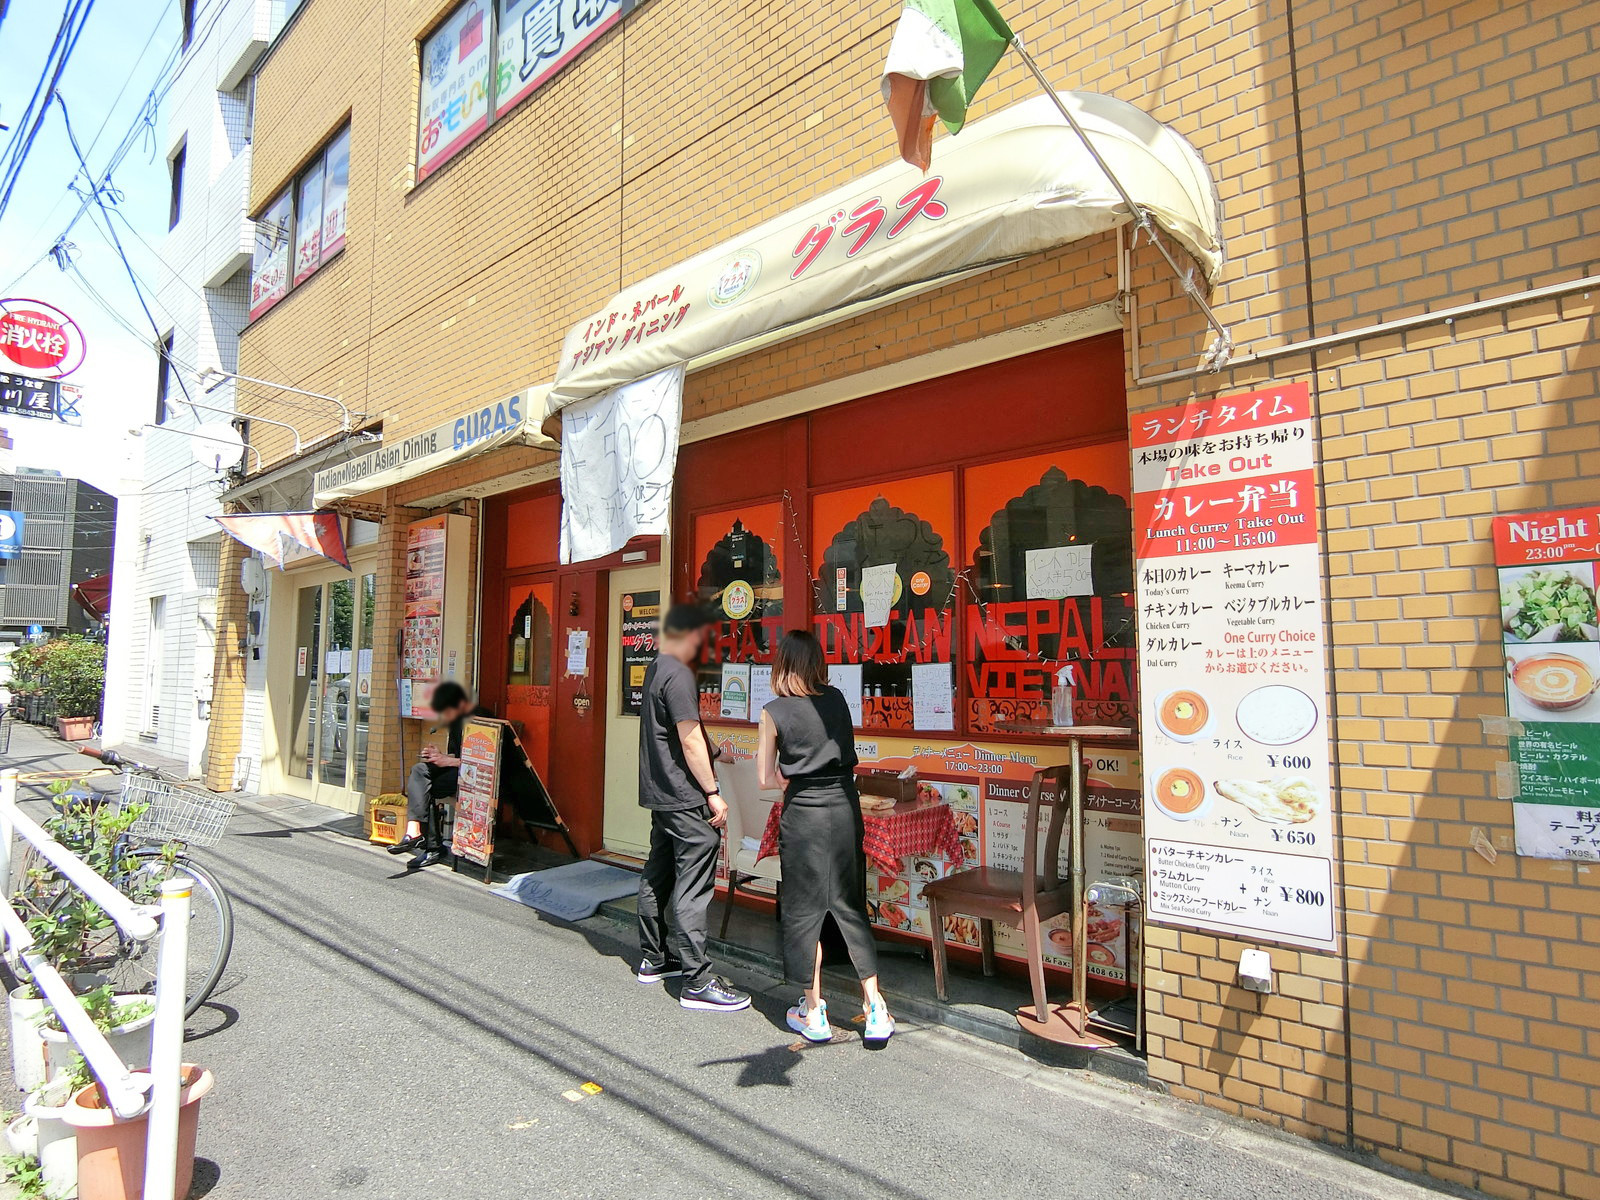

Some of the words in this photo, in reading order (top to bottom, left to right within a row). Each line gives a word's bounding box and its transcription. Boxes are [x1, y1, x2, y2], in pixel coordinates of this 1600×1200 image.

[790, 175, 949, 281] グラス
[0, 321, 66, 357] 消火栓
[453, 395, 522, 451] GURAS
[1142, 395, 1293, 440] ランチタイム
[375, 448, 401, 473] Asian
[403, 432, 438, 462] Dining
[1137, 427, 1305, 465] 本場の味をお持ち帰り
[1166, 461, 1221, 482] Take
[1228, 453, 1273, 472] Out
[1153, 480, 1298, 522] カレー弁当
[1146, 525, 1186, 539] Lunch
[1190, 521, 1229, 536] Curry
[1235, 516, 1273, 530] Take
[1278, 512, 1305, 525] Out
[1508, 517, 1588, 544] Night
[1142, 566, 1211, 584] 本日のカレー
[1223, 560, 1290, 578] キーマカレー
[1145, 587, 1170, 596] Today's
[1171, 587, 1189, 595] Curry
[1225, 581, 1245, 590] Keema
[1246, 580, 1265, 588] Curry
[1144, 602, 1213, 618] チキンカレー
[1224, 596, 1315, 613] ベジタブルカレー
[1145, 622, 1170, 630] Chicken
[1172, 621, 1190, 629] Curry
[1226, 617, 1256, 627] Vegetable
[1257, 617, 1275, 625] Curry
[813, 607, 952, 664] INDIAN
[1224, 632, 1245, 643] One
[1247, 631, 1276, 645] Curry
[1279, 630, 1316, 642] Choice
[1146, 637, 1202, 652] ダルカレー
[1205, 647, 1314, 659] カレーは上のメニュー
[1159, 659, 1177, 667] Curry
[1205, 662, 1309, 674] からお選びください。
[574, 697, 590, 706] open
[1519, 730, 1551, 738] ビール
[730, 744, 749, 755] Menu
[1212, 739, 1243, 749] ライス
[1518, 741, 1578, 749] 世界の有名ビール
[913, 746, 971, 759] ディナーメニュー
[974, 749, 1007, 762] Dinner
[1009, 751, 1038, 764] Menu
[1267, 755, 1311, 769] ¥600
[1520, 752, 1588, 761] ビール・カクテル
[988, 783, 1020, 798] Dinner
[1022, 786, 1055, 802] Crse
[1086, 794, 1141, 811] ディナーコース
[1521, 786, 1589, 796] ベリーベリーモヒート
[997, 821, 1011, 829] Course
[1221, 817, 1243, 828] ナン
[378, 824, 396, 836] KIRIN
[1229, 830, 1249, 839] Naan
[1271, 828, 1316, 846] ¥650
[1158, 847, 1244, 863] バターチキンカレー
[1158, 858, 1174, 866] Butter
[1174, 860, 1195, 868] Chicken
[1196, 863, 1210, 872] Curry
[1251, 866, 1273, 876] ライス
[1159, 869, 1204, 882] ラムカレー
[1160, 880, 1182, 889] Mutton
[1184, 883, 1200, 893] Curry
[1160, 891, 1247, 911] ミックスシーフードカレー
[1254, 897, 1272, 907] ナン
[1279, 886, 1325, 907] ¥800
[1182, 905, 1195, 913] Food
[1196, 908, 1211, 917] Curry
[1263, 909, 1278, 917] Naan
